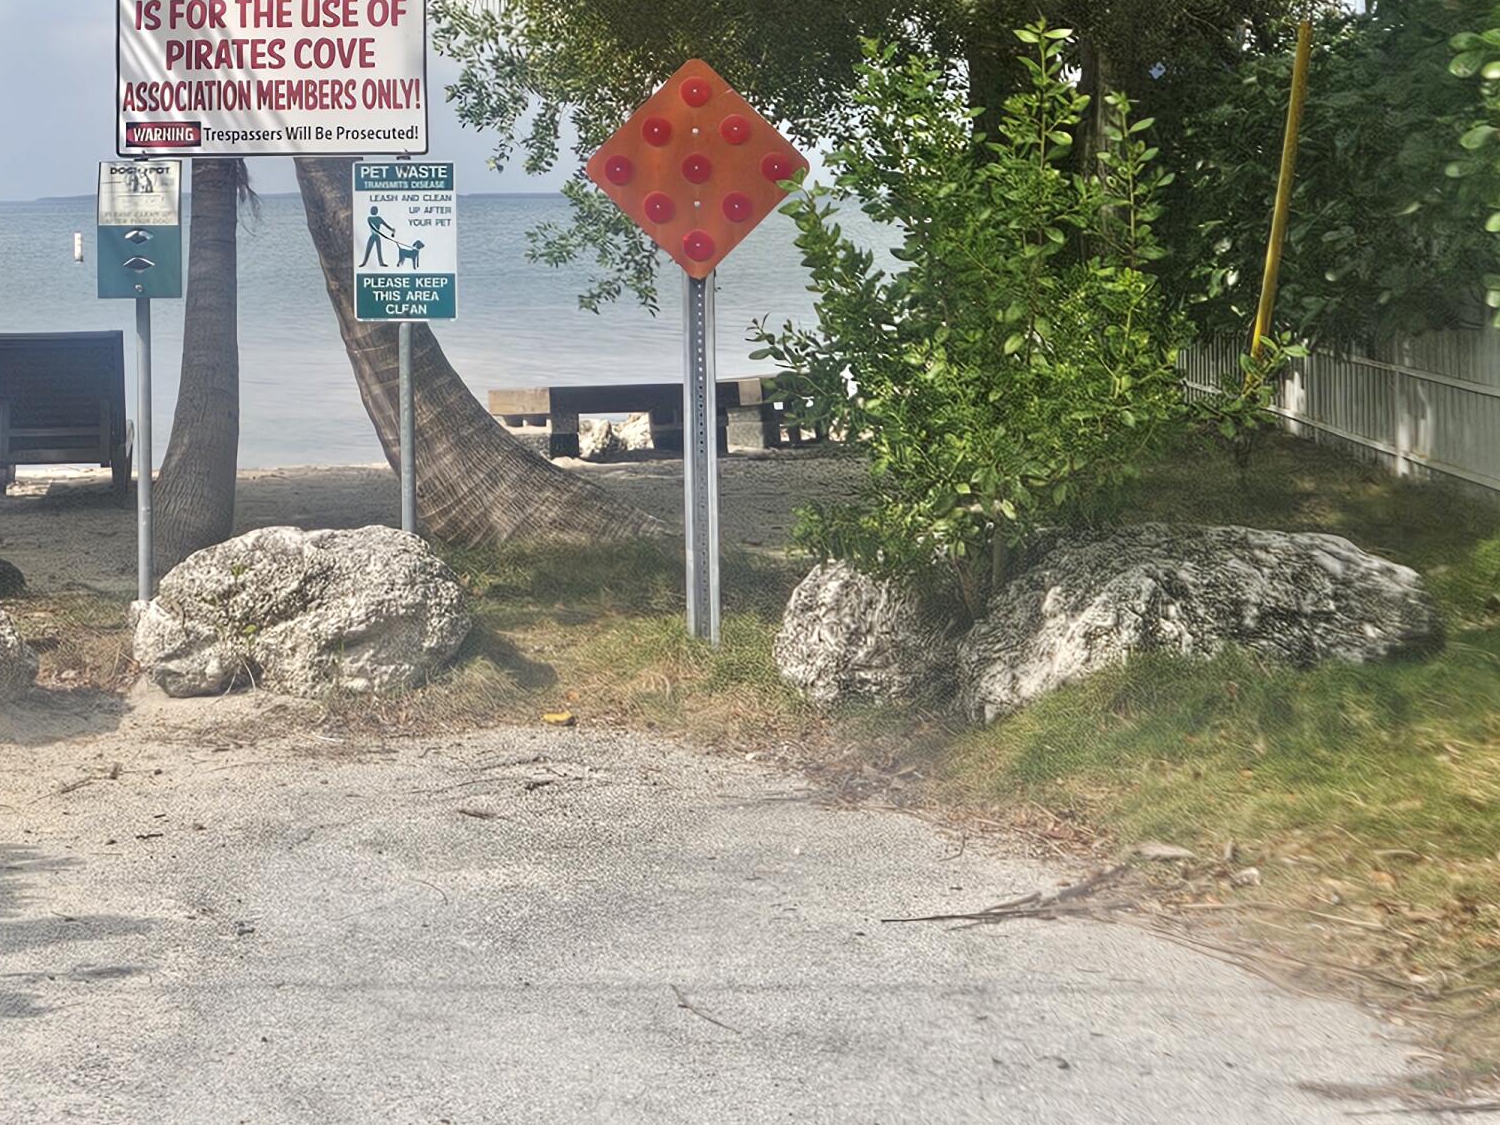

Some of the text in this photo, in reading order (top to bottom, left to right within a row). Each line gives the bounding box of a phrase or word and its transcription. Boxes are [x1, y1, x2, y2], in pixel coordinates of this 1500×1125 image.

[135, 0, 162, 31] IS
[166, 37, 376, 71] PIRATES COVE
[123, 78, 421, 112] ASSOCIATION MEMBERS ONLY!
[133, 125, 419, 144] WARNING Trespassers Will Be Prosecuted!
[361, 165, 448, 178] PET WASTE
[364, 180, 445, 189] TRANSMITS DISEASE
[369, 194, 452, 202] LEASH AND CLEAN
[408, 206, 452, 214] UP AFTER
[408, 218, 452, 226] YOUR PET
[363, 277, 448, 288] PLEASE KEEP
[372, 290, 440, 302] THIS AREA
[385, 304, 427, 315] CLEAN
